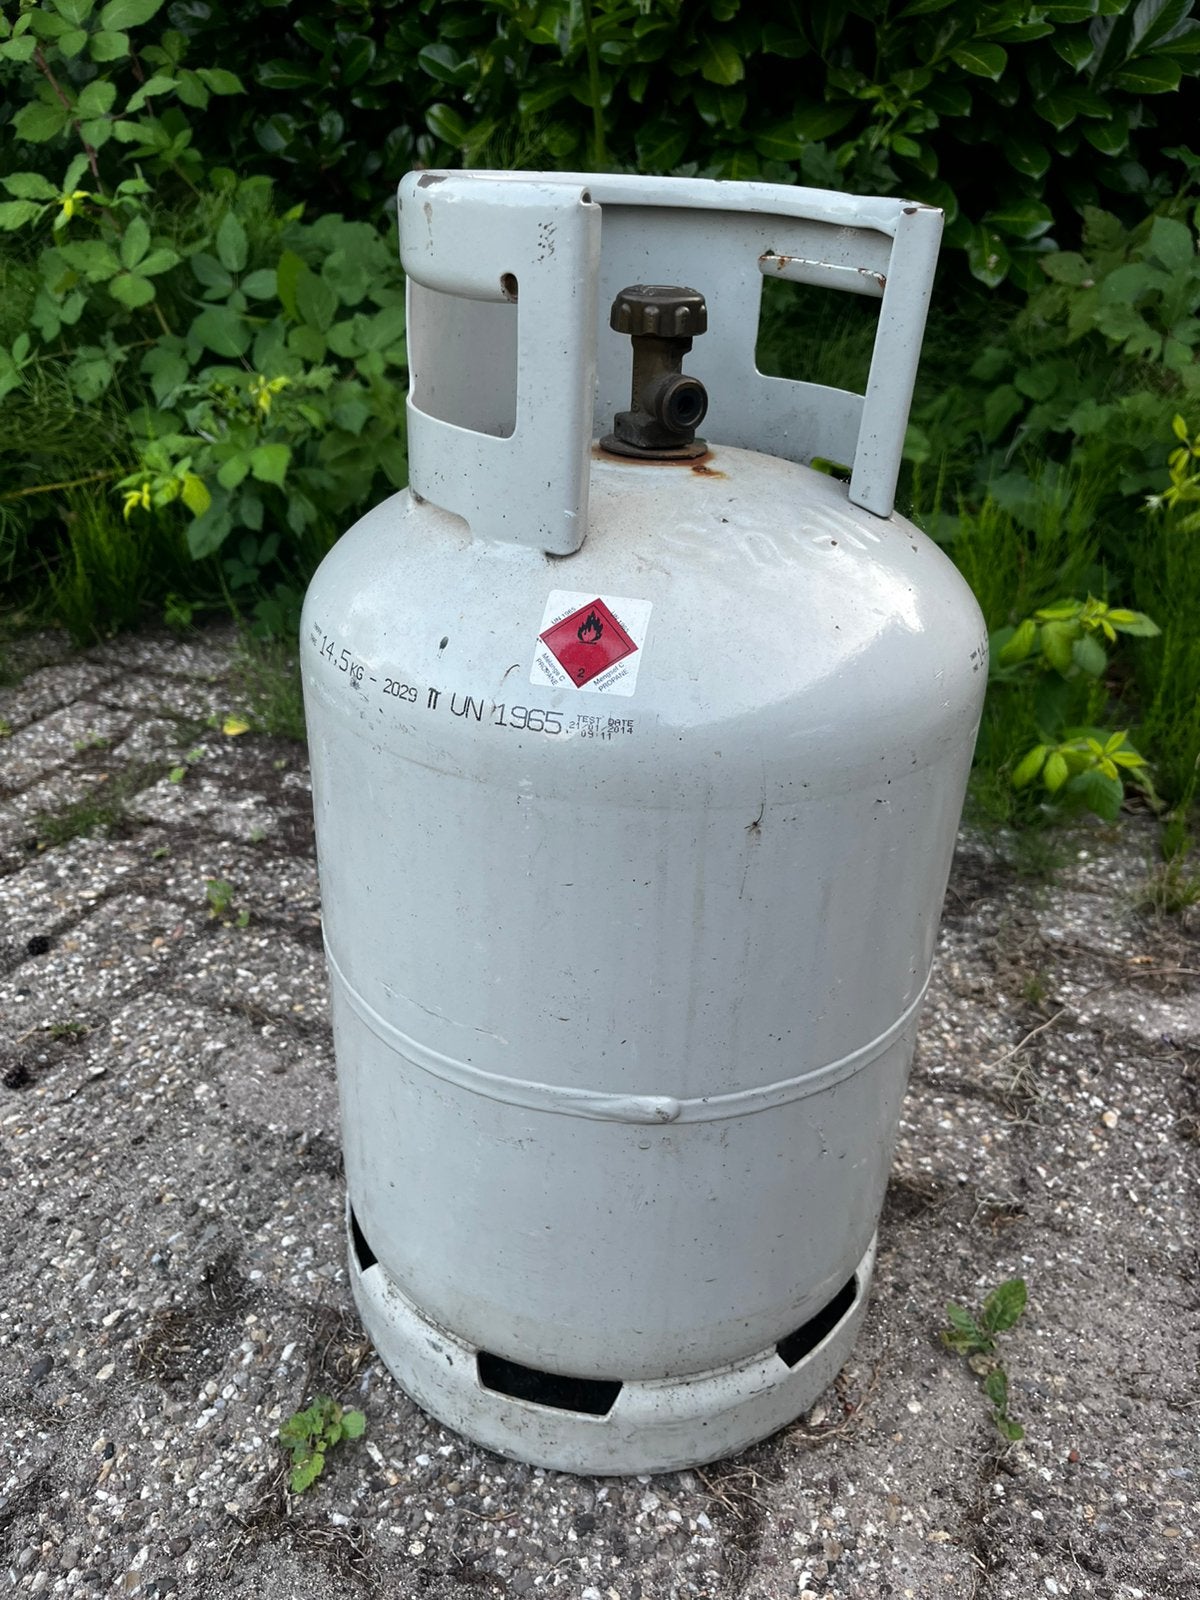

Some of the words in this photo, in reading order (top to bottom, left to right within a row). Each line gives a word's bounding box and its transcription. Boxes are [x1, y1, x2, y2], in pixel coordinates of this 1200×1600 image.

[536, 657, 559, 686] PROPANE
[577, 667, 585, 678] 2
[598, 669, 630, 692] PROPANE
[383, 678, 418, 703] 2029
[450, 692, 484, 722] UN
[568, 720, 634, 735] 21/01/2014
[576, 714, 602, 725] TEST
[607, 717, 635, 728] DATE
